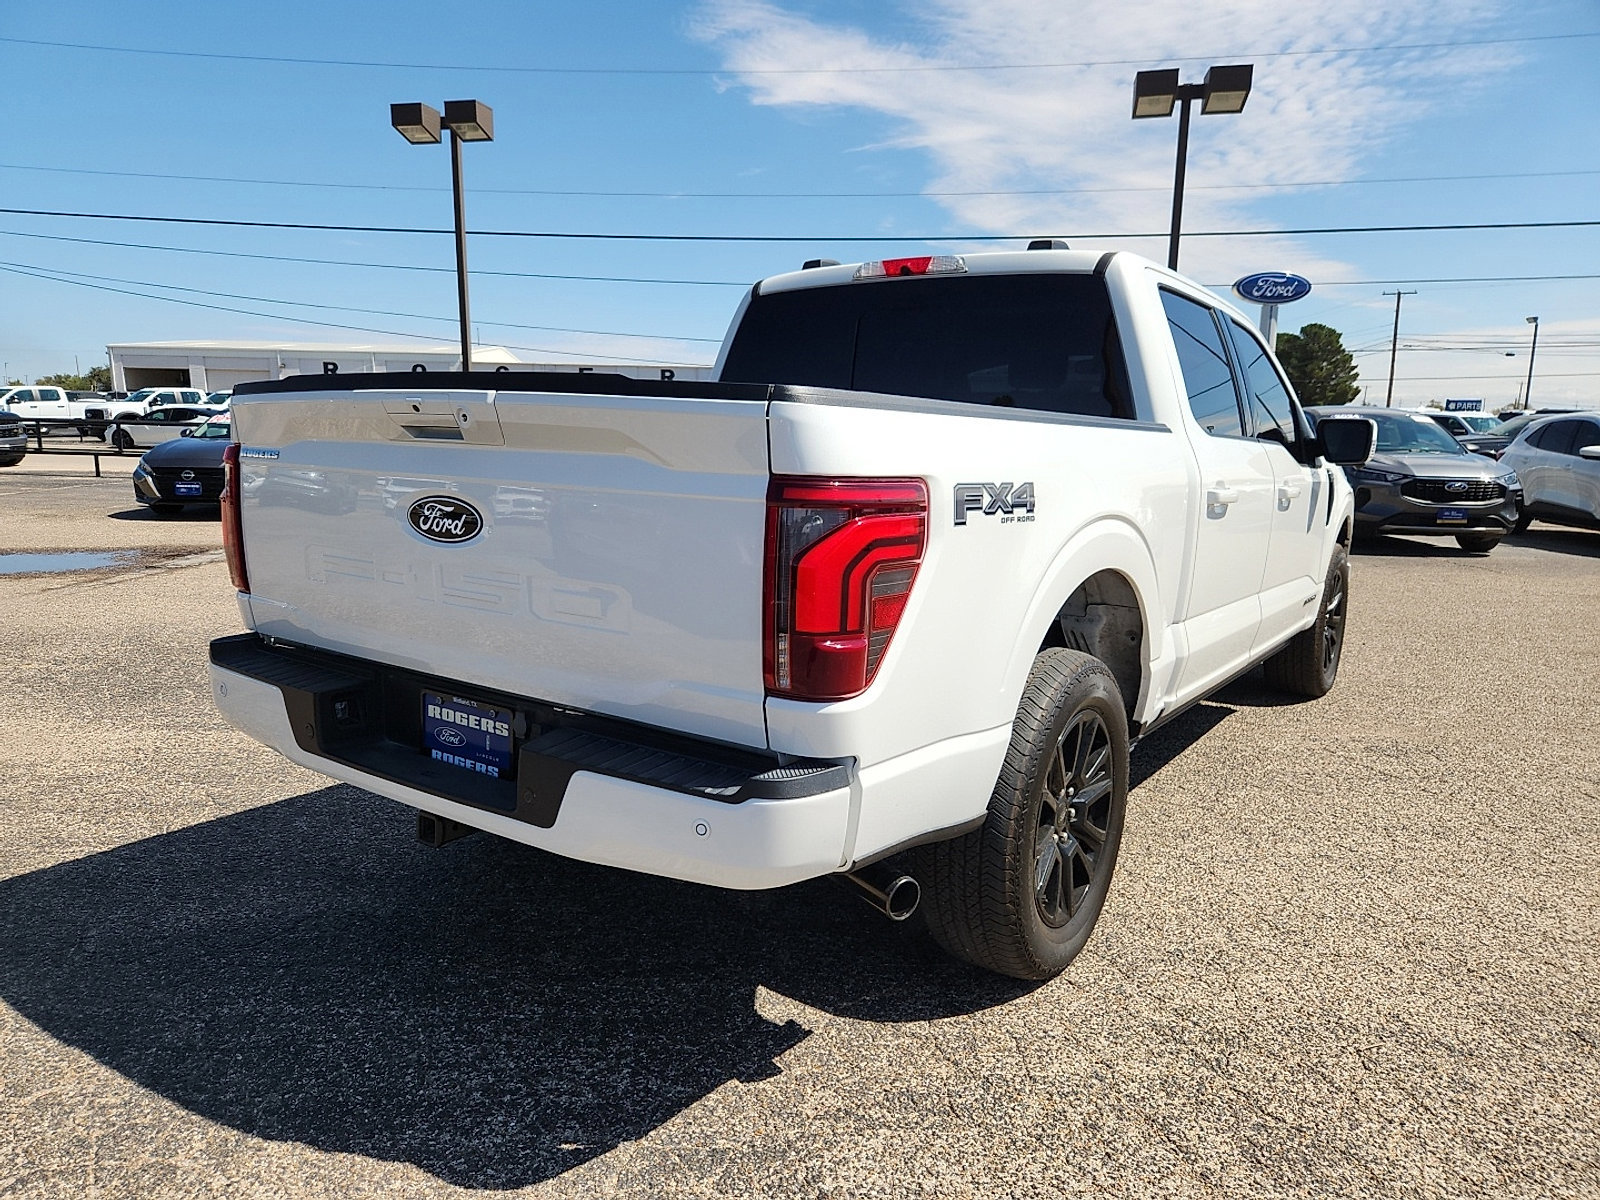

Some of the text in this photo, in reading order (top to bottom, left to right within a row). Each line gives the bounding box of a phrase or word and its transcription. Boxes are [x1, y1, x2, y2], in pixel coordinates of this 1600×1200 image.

[1252, 277, 1298, 297] Ford
[1456, 402, 1481, 410] PARTS
[953, 482, 1036, 526] FX4
[419, 502, 466, 537] Ford
[1000, 515, 1036, 524] OFF ROAD
[427, 704, 509, 737] ROGERS
[439, 728, 461, 745] Ford
[431, 748, 499, 778] ROGERS
